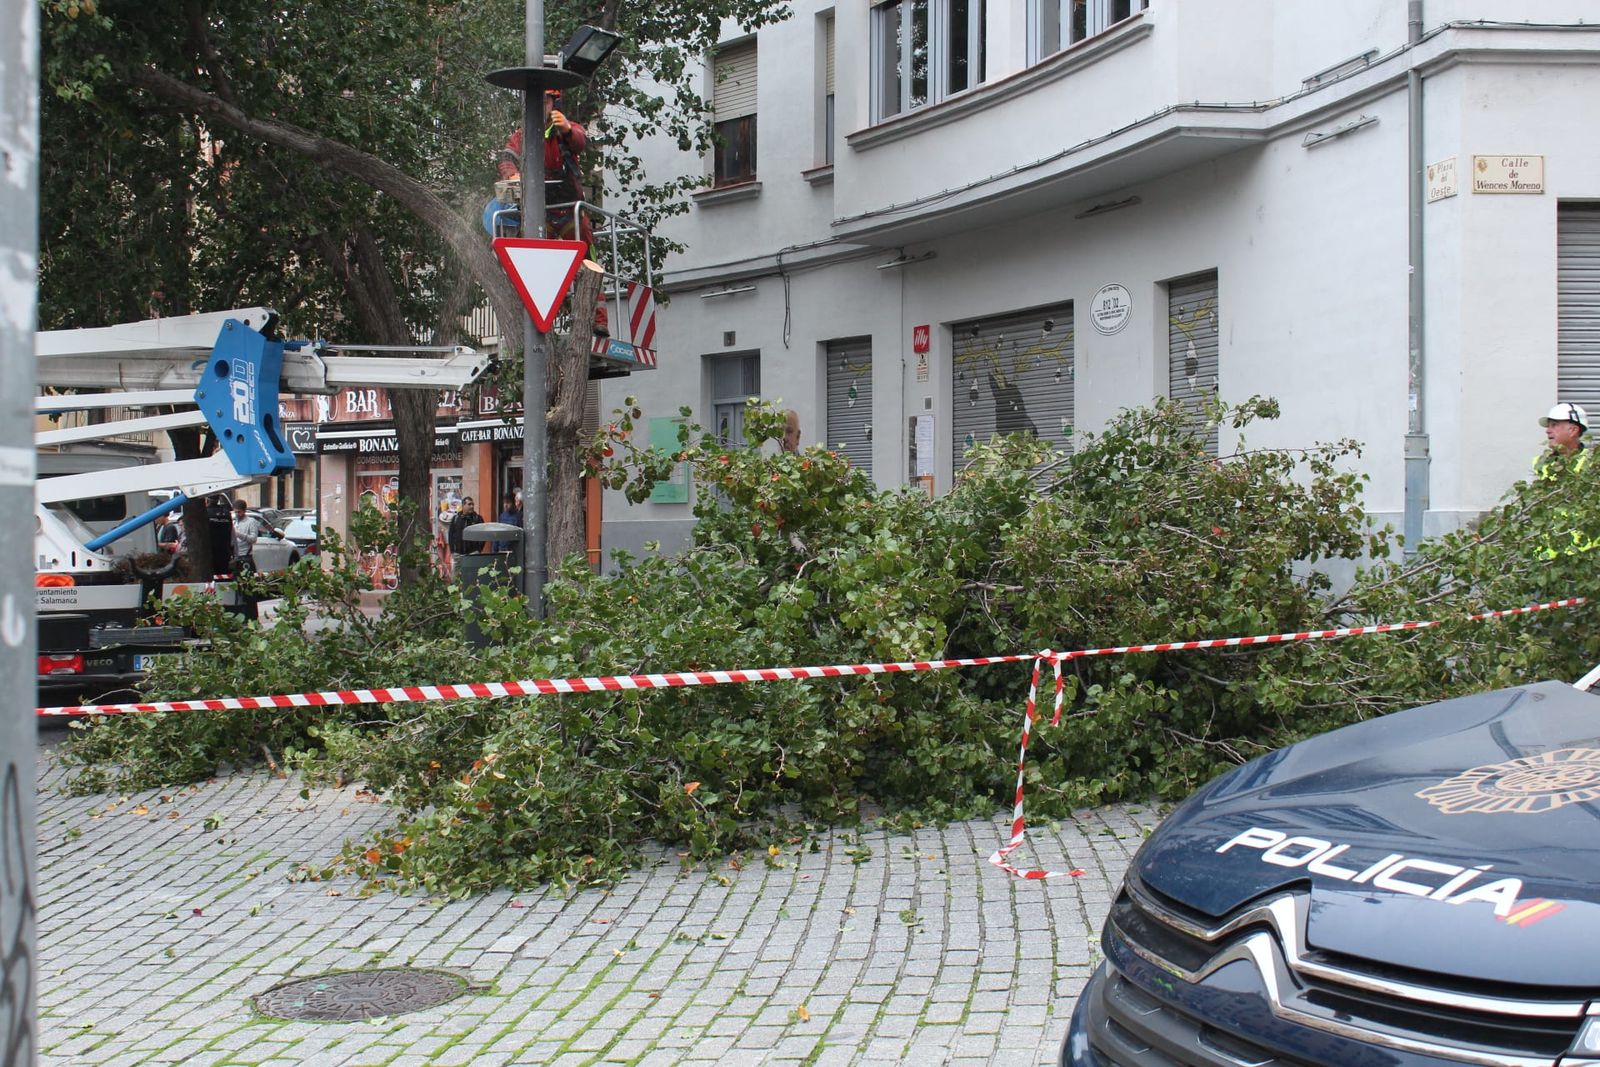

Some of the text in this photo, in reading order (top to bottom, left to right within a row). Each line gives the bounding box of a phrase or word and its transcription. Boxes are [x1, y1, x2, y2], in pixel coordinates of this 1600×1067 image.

[1437, 163, 1453, 174] Plaza
[1501, 158, 1529, 168] Calle
[1509, 170, 1519, 179] de
[1476, 180, 1541, 190] Wences Moreno
[1430, 185, 1452, 199] Oeste
[915, 328, 929, 351] illy
[233, 358, 250, 425] 20D
[345, 389, 381, 417] BAR
[493, 426, 525, 440] BONANZ
[359, 437, 400, 452] BONANZ
[356, 454, 401, 465] COMBINADOS
[431, 452, 463, 462] RACIONE
[35, 588, 78, 597] yuntamiento
[40, 596, 78, 605] Salamanca
[85, 658, 114, 668] VECO
[1216, 827, 1523, 916] POLICÍA
